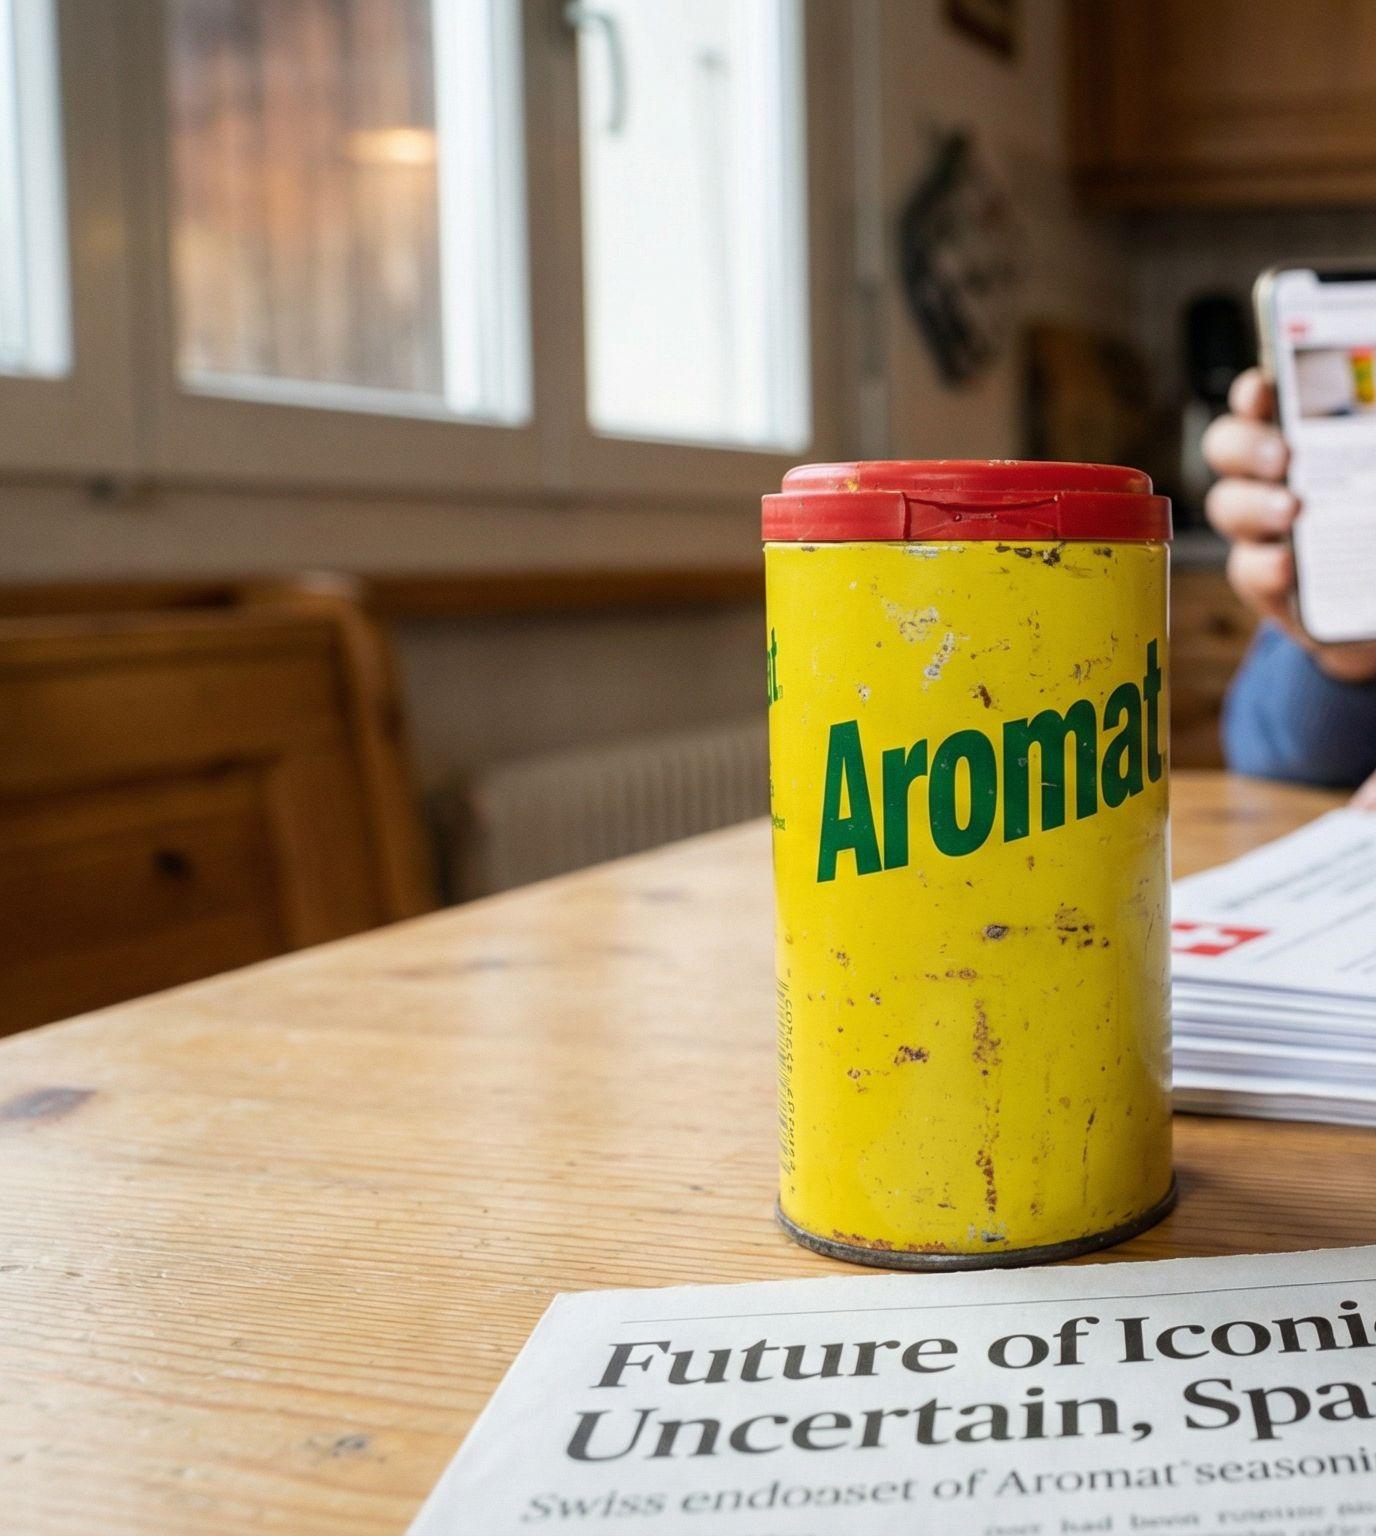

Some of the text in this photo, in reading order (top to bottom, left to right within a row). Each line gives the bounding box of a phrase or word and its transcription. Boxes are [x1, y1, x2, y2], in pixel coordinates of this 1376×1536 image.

[816, 637, 1163, 884] Aromat
[589, 1337, 960, 1390] Future
[986, 1315, 1101, 1371] of
[565, 1385, 1154, 1463] Uncertain,
[521, 1489, 668, 1524] Swiss
[932, 1468, 987, 1500] of
